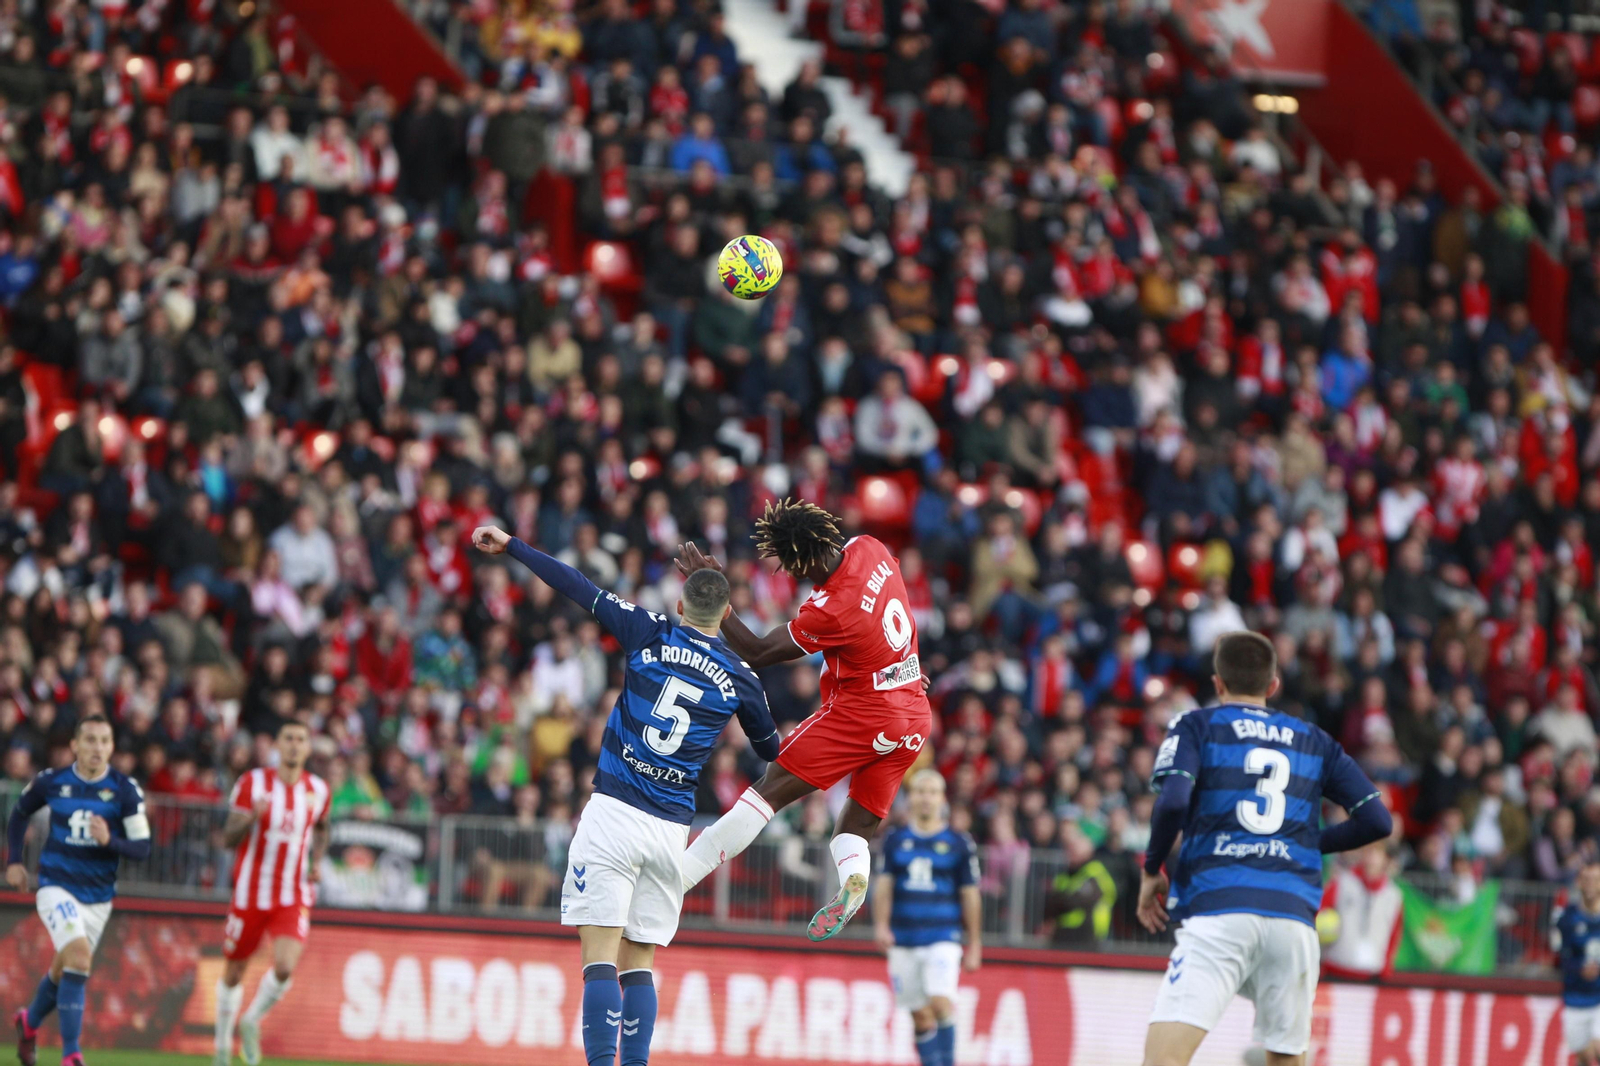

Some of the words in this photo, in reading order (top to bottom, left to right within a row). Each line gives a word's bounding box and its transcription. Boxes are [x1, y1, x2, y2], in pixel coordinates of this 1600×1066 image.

[860, 594, 877, 614] EL
[882, 597, 912, 660] 9
[641, 648, 658, 664] G.
[661, 645, 737, 702] RODRÍGUEZ
[642, 675, 705, 756] 5
[1231, 718, 1295, 746] EDGAR
[1235, 747, 1291, 835] 3
[339, 950, 566, 1048] SABOR
